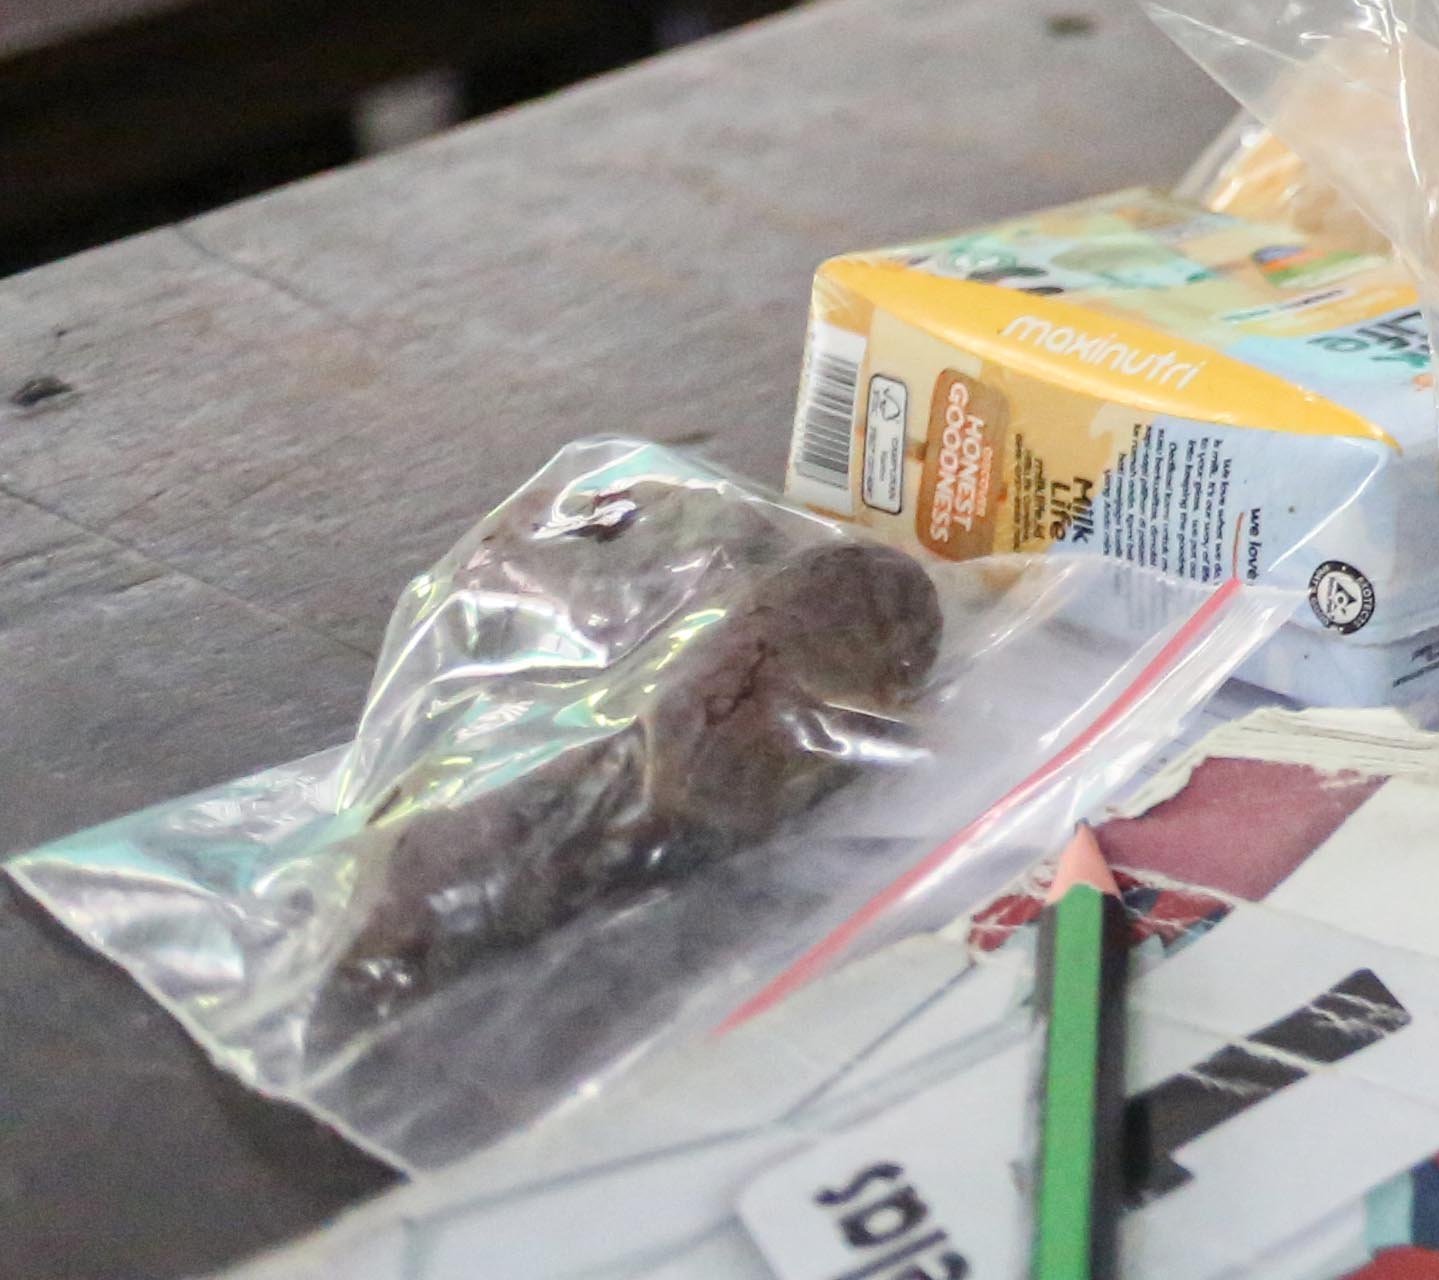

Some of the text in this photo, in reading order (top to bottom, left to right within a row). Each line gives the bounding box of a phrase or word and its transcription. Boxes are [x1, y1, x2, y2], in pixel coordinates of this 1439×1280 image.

[1001, 314, 1207, 391] maxinutri
[929, 382, 969, 543] GOODNESS
[953, 415, 984, 531] HONEST
[1050, 482, 1072, 540] Life
[1072, 477, 1094, 543] Milk
[1247, 508, 1262, 580] we love
